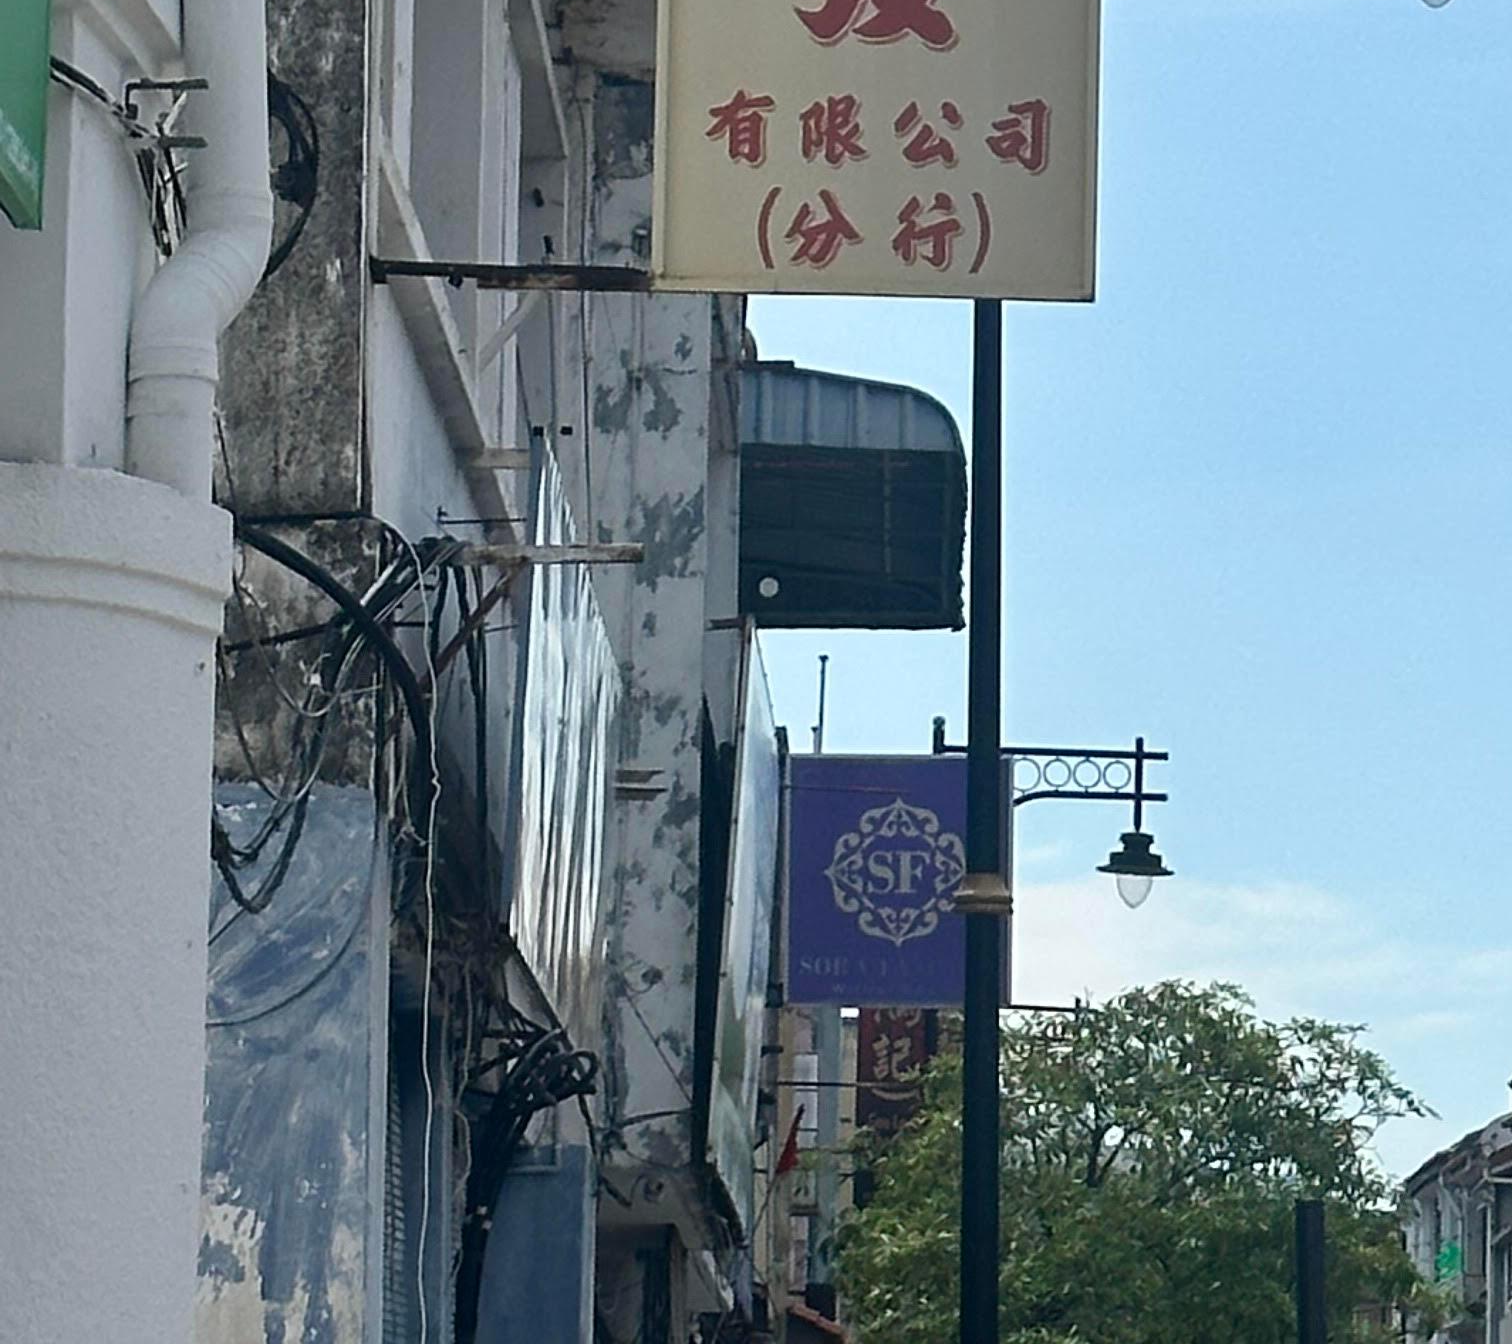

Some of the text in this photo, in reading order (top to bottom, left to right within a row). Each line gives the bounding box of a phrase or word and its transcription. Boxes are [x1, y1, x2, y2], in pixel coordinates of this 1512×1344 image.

[704, 89, 1054, 175] 有限公司
[757, 186, 992, 276] (分行)
[867, 850, 931, 896] SF
